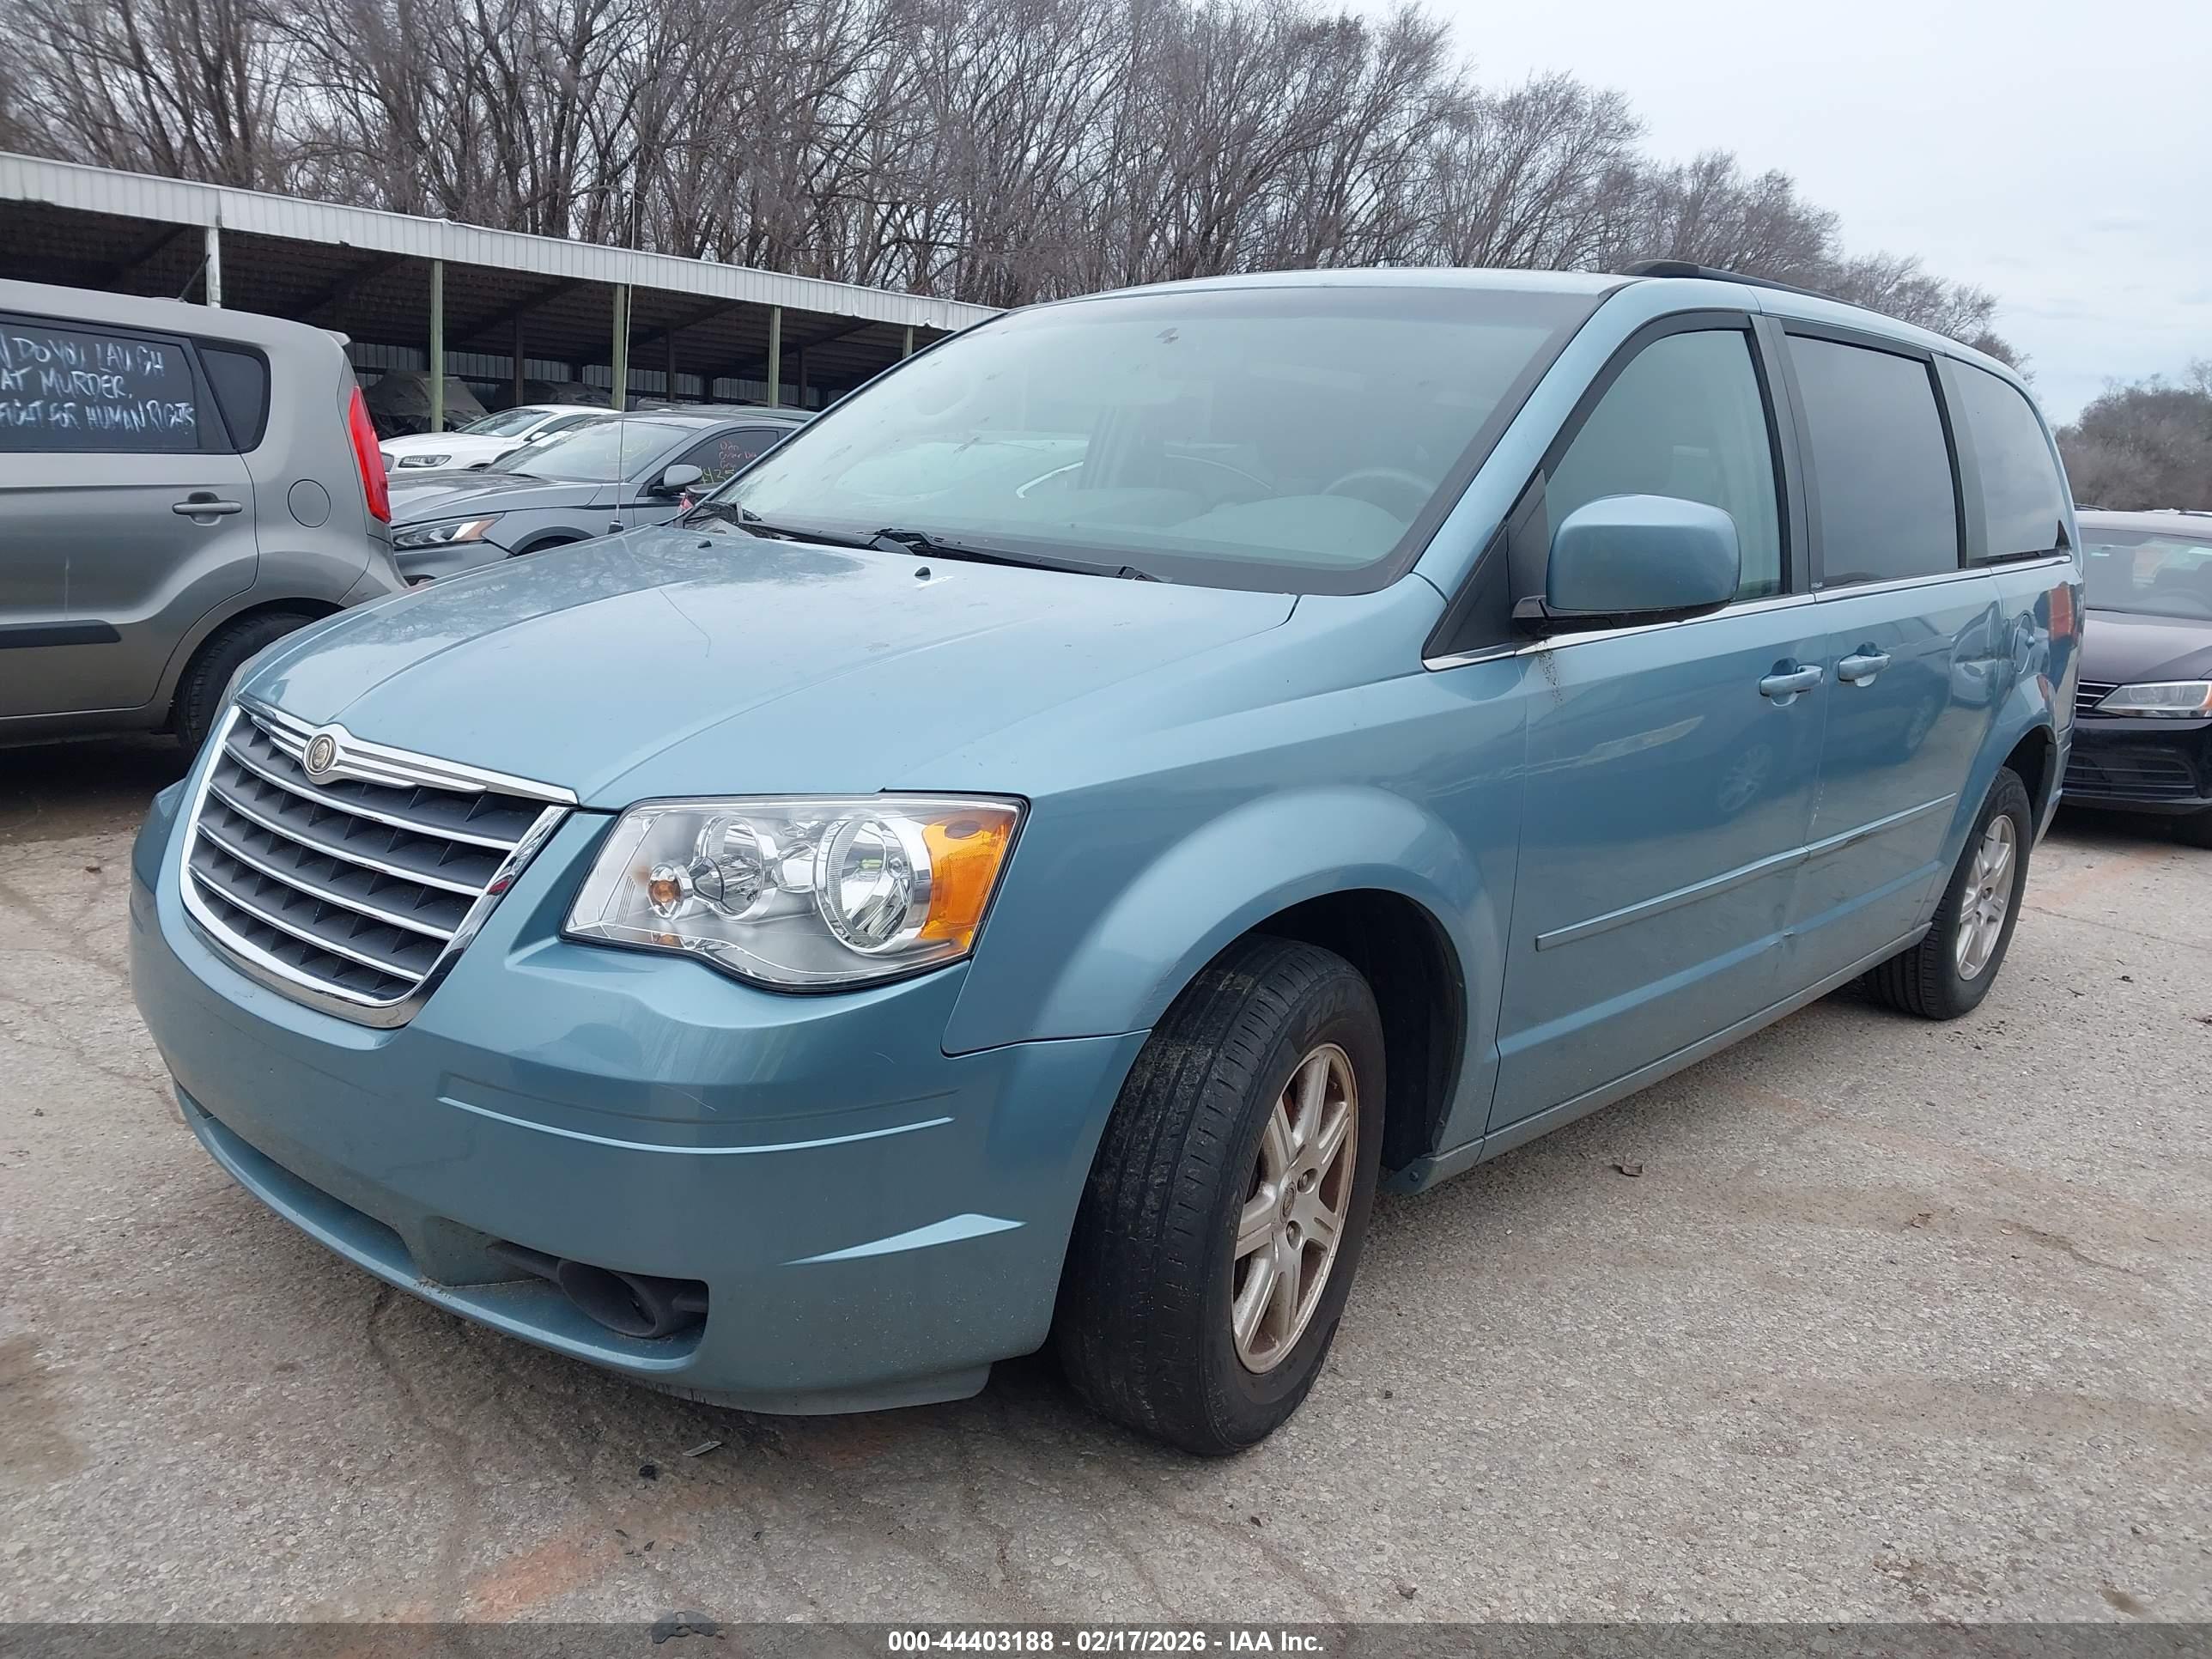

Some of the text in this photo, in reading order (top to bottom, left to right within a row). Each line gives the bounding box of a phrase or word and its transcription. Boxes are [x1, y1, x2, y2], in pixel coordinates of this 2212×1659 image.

[11, 337, 52, 362] DO
[48, 339, 87, 368] YOU
[95, 343, 164, 376] LAUGH
[1, 366, 33, 392] AT
[48, 402, 82, 430] FOR
[85, 401, 146, 433] HUMAN
